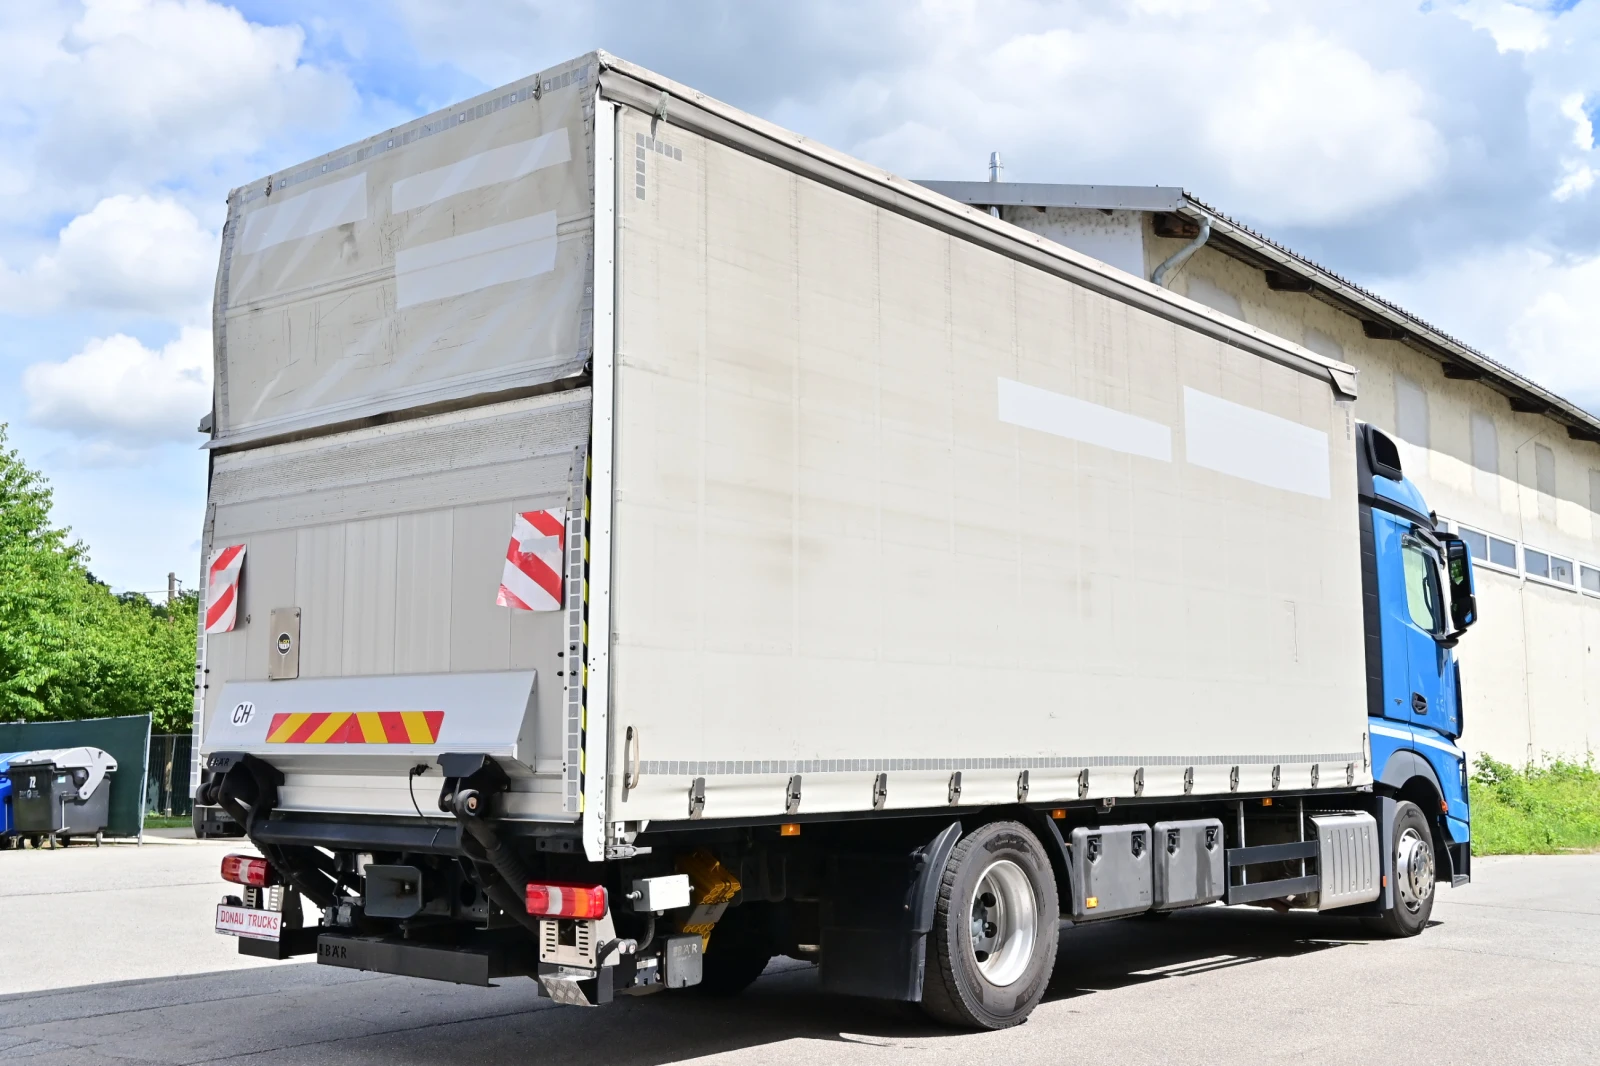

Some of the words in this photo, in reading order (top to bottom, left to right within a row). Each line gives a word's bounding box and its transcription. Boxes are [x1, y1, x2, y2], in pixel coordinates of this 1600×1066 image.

[233, 704, 253, 724] CH
[220, 910, 244, 925] DONAU
[248, 914, 278, 930] TRUCKS
[325, 944, 347, 959] BÄR
